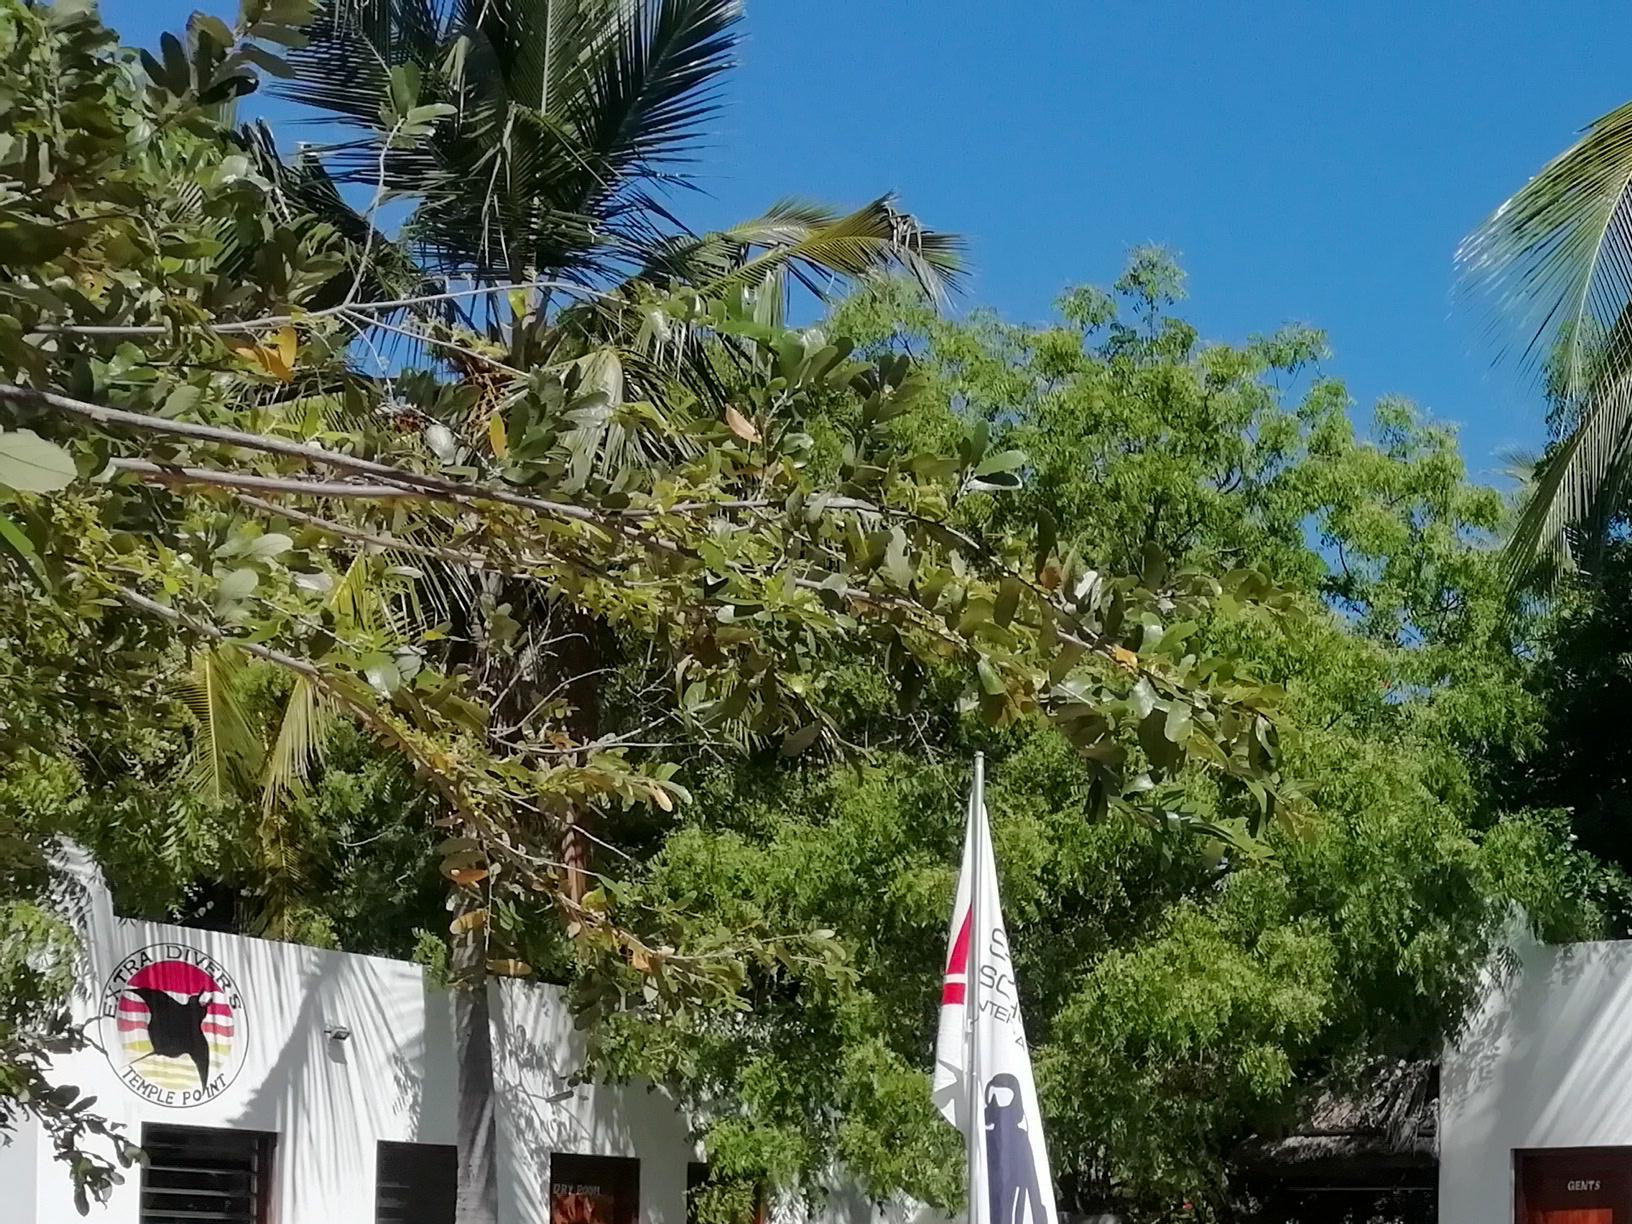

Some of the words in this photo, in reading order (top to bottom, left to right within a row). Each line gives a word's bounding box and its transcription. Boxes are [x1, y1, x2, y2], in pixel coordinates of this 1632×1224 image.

[104, 951, 153, 1018] EXTRA
[166, 945, 242, 1010] DIVERS
[122, 1066, 176, 1105] TEMPLE
[183, 1073, 227, 1105] POINT
[1567, 1180, 1601, 1191] GENTS
